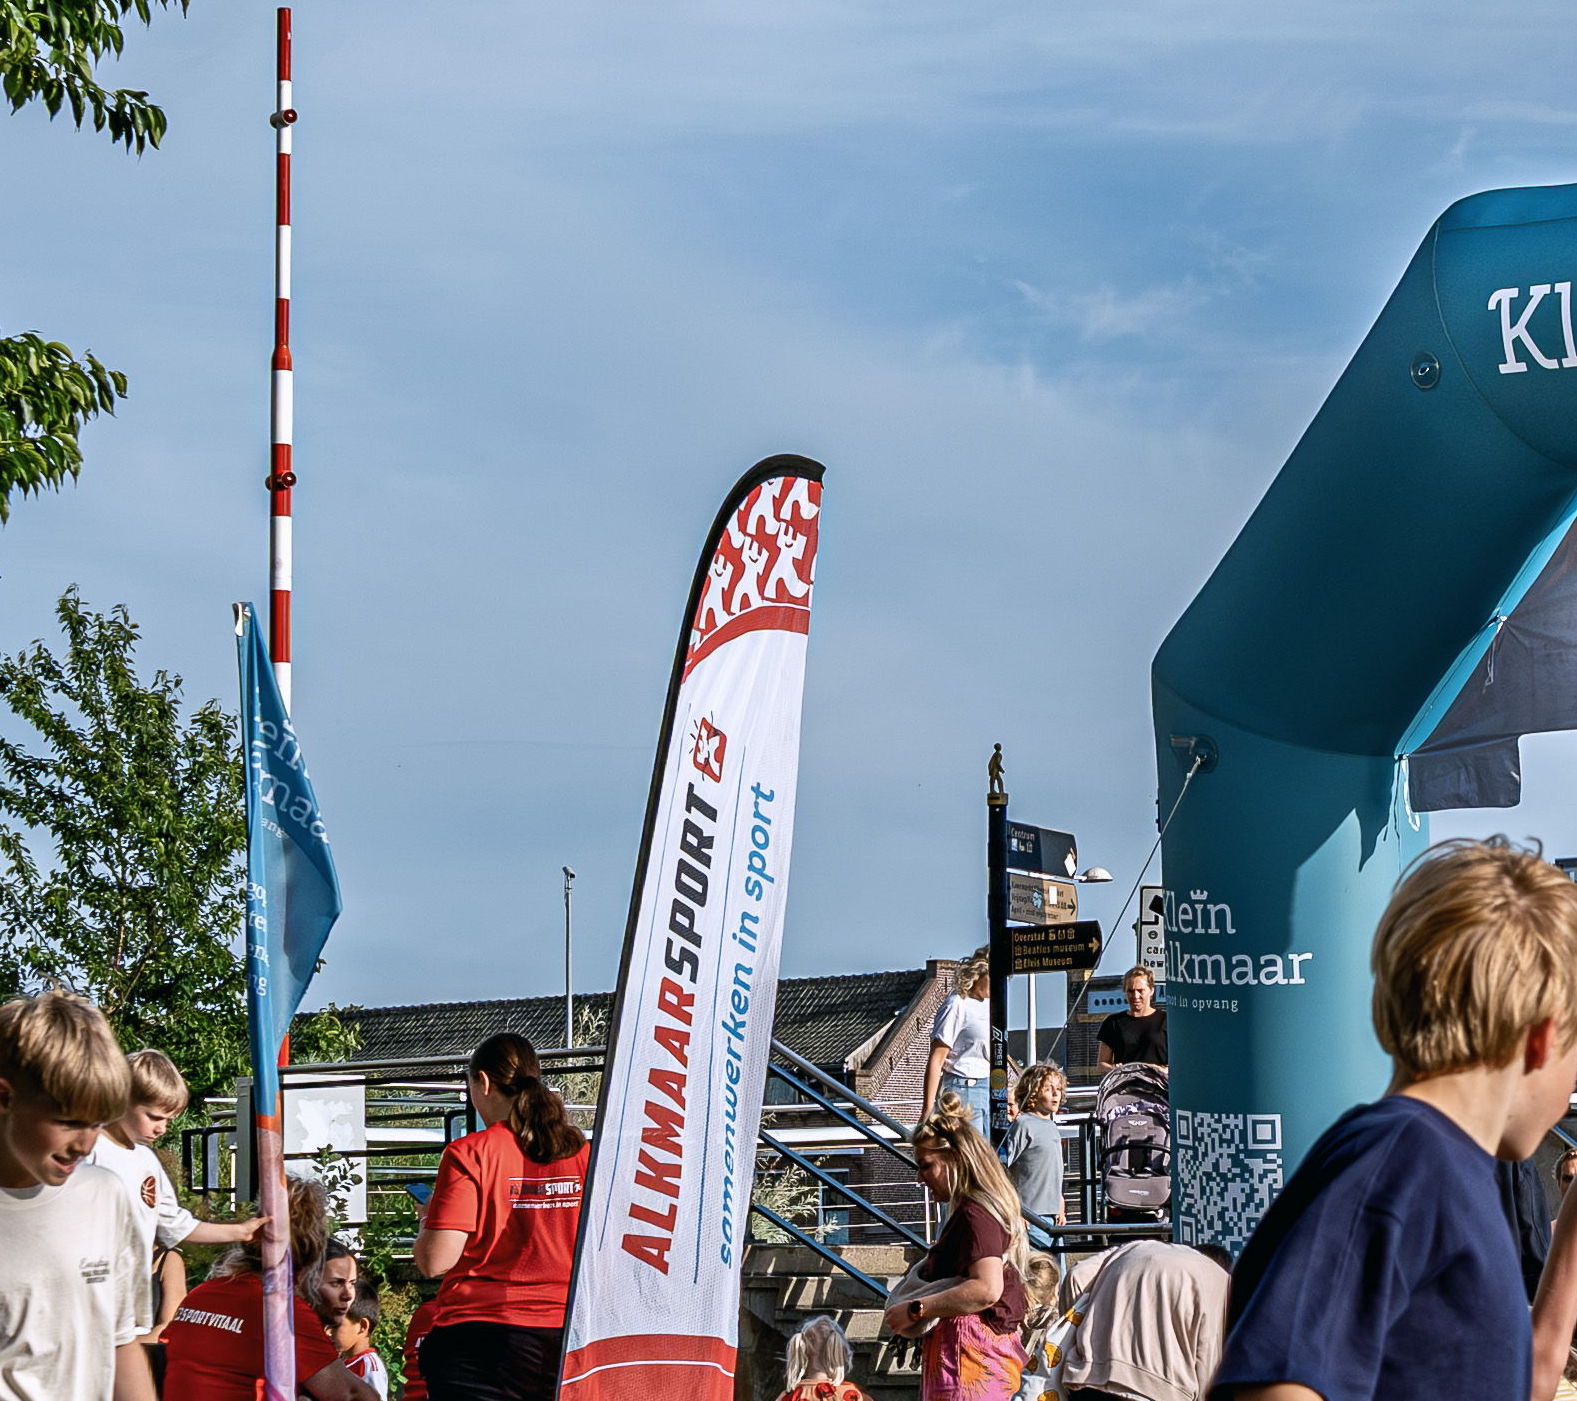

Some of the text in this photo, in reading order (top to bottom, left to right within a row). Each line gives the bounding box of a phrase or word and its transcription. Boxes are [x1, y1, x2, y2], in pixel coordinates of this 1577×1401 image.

[621, 781, 718, 1276] ALKMAARSPORT
[720, 781, 776, 1270] samenwerken in sport
[1023, 957, 1073, 968] Elvis Museum
[1192, 998, 1239, 1013] opvang
